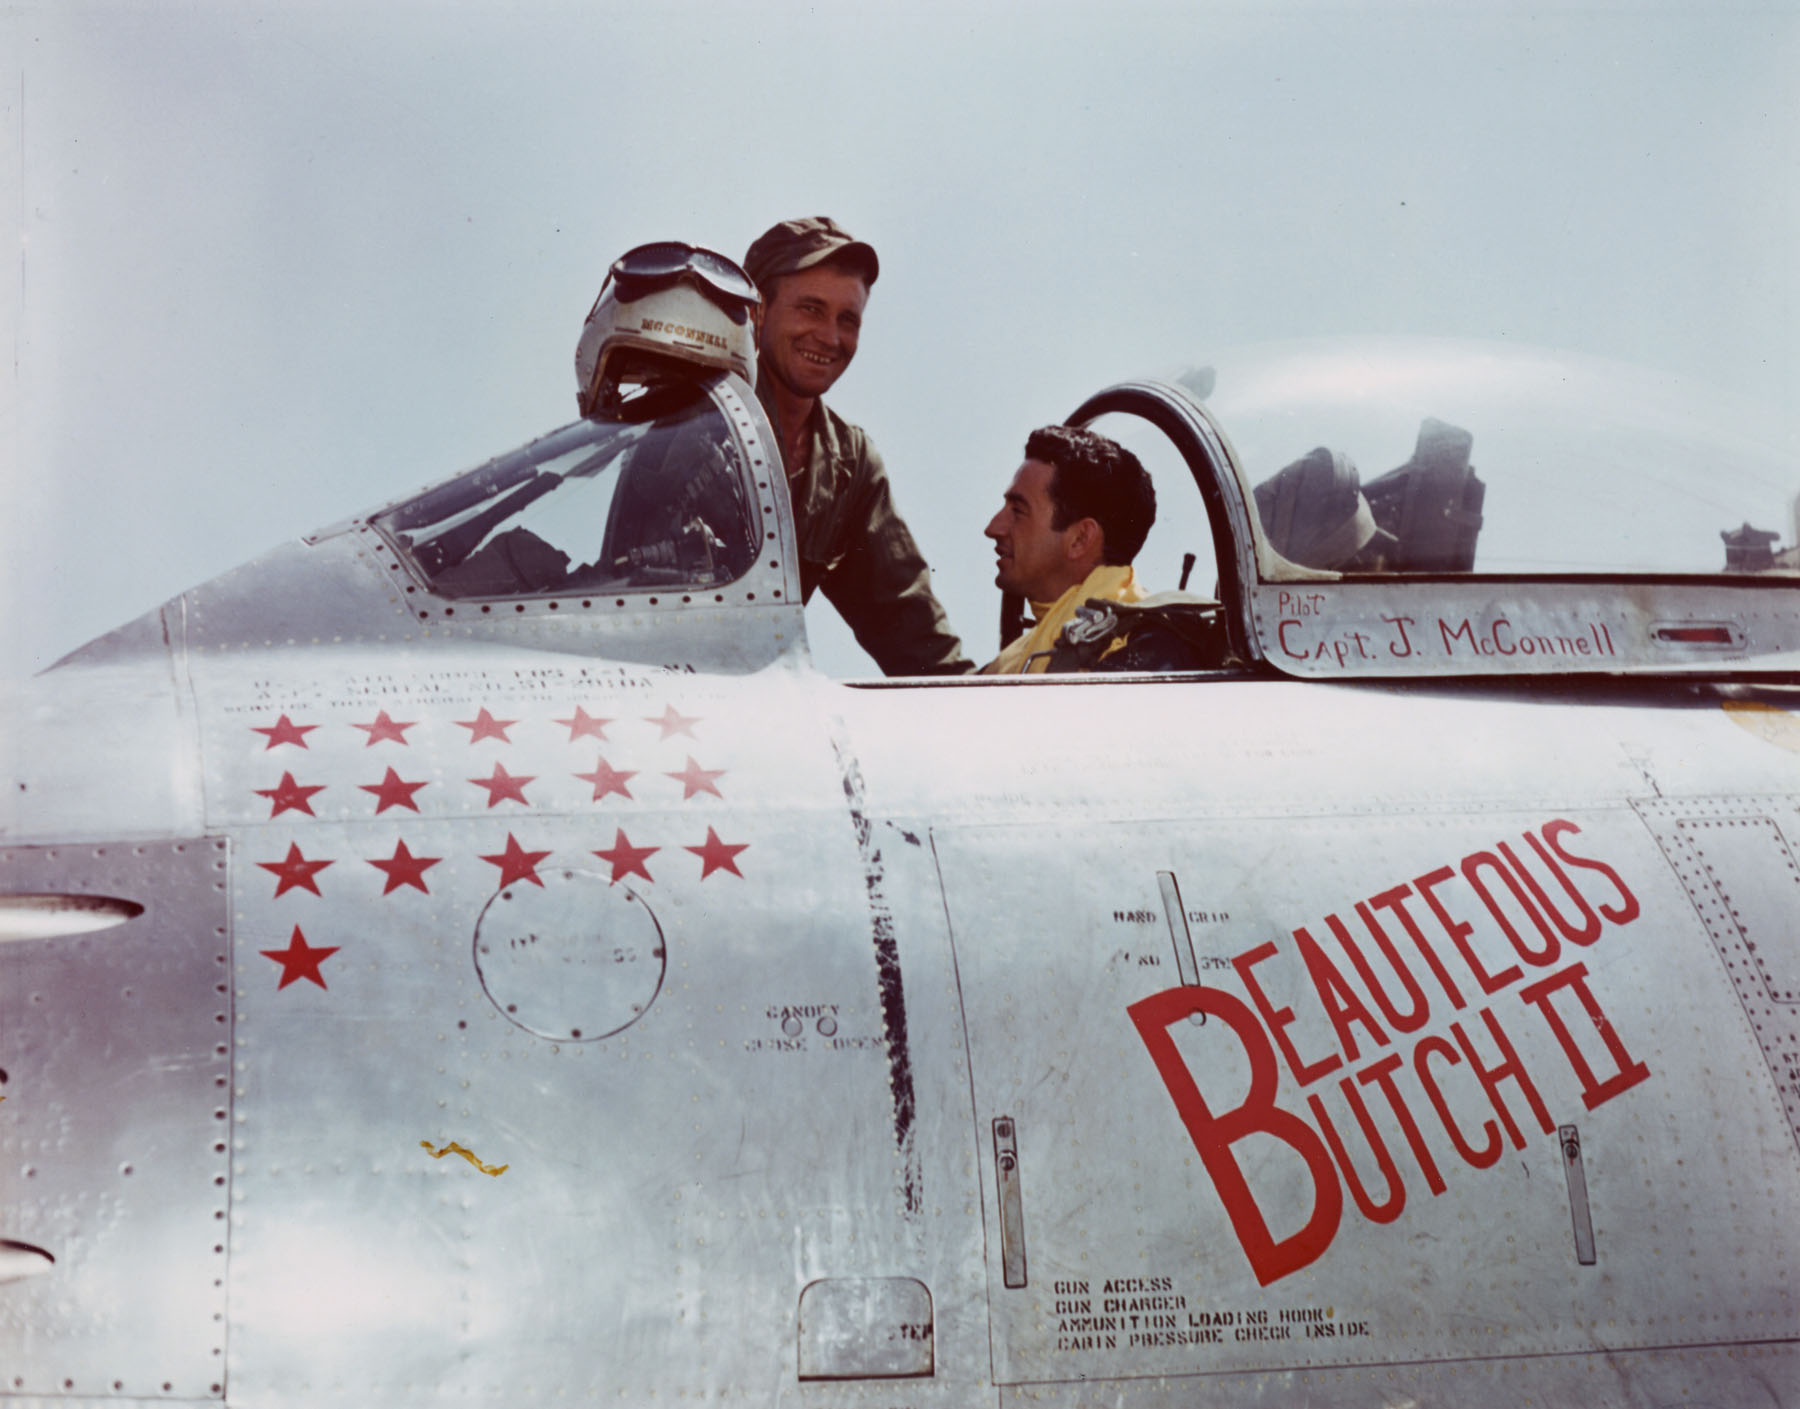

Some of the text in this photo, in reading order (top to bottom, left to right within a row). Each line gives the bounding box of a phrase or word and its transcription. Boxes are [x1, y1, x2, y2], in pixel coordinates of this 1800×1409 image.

[1279, 591, 1325, 616] Pilot
[1380, 614, 1421, 657] J.
[1438, 618, 1616, 657] McConnell
[1518, 961, 1651, 1112] II
[1127, 818, 1640, 1287] BEAUTEOUS
[1054, 1276, 1173, 1295] GUN ACCESS
[1055, 1295, 1187, 1315] GUN CHARGER
[1058, 1307, 1324, 1333] AMMUNITION LOADING HOOK
[1129, 1327, 1223, 1347] PRESSURE
[1234, 1325, 1291, 1342] CHECK
[1305, 1320, 1370, 1339] INSIDE
